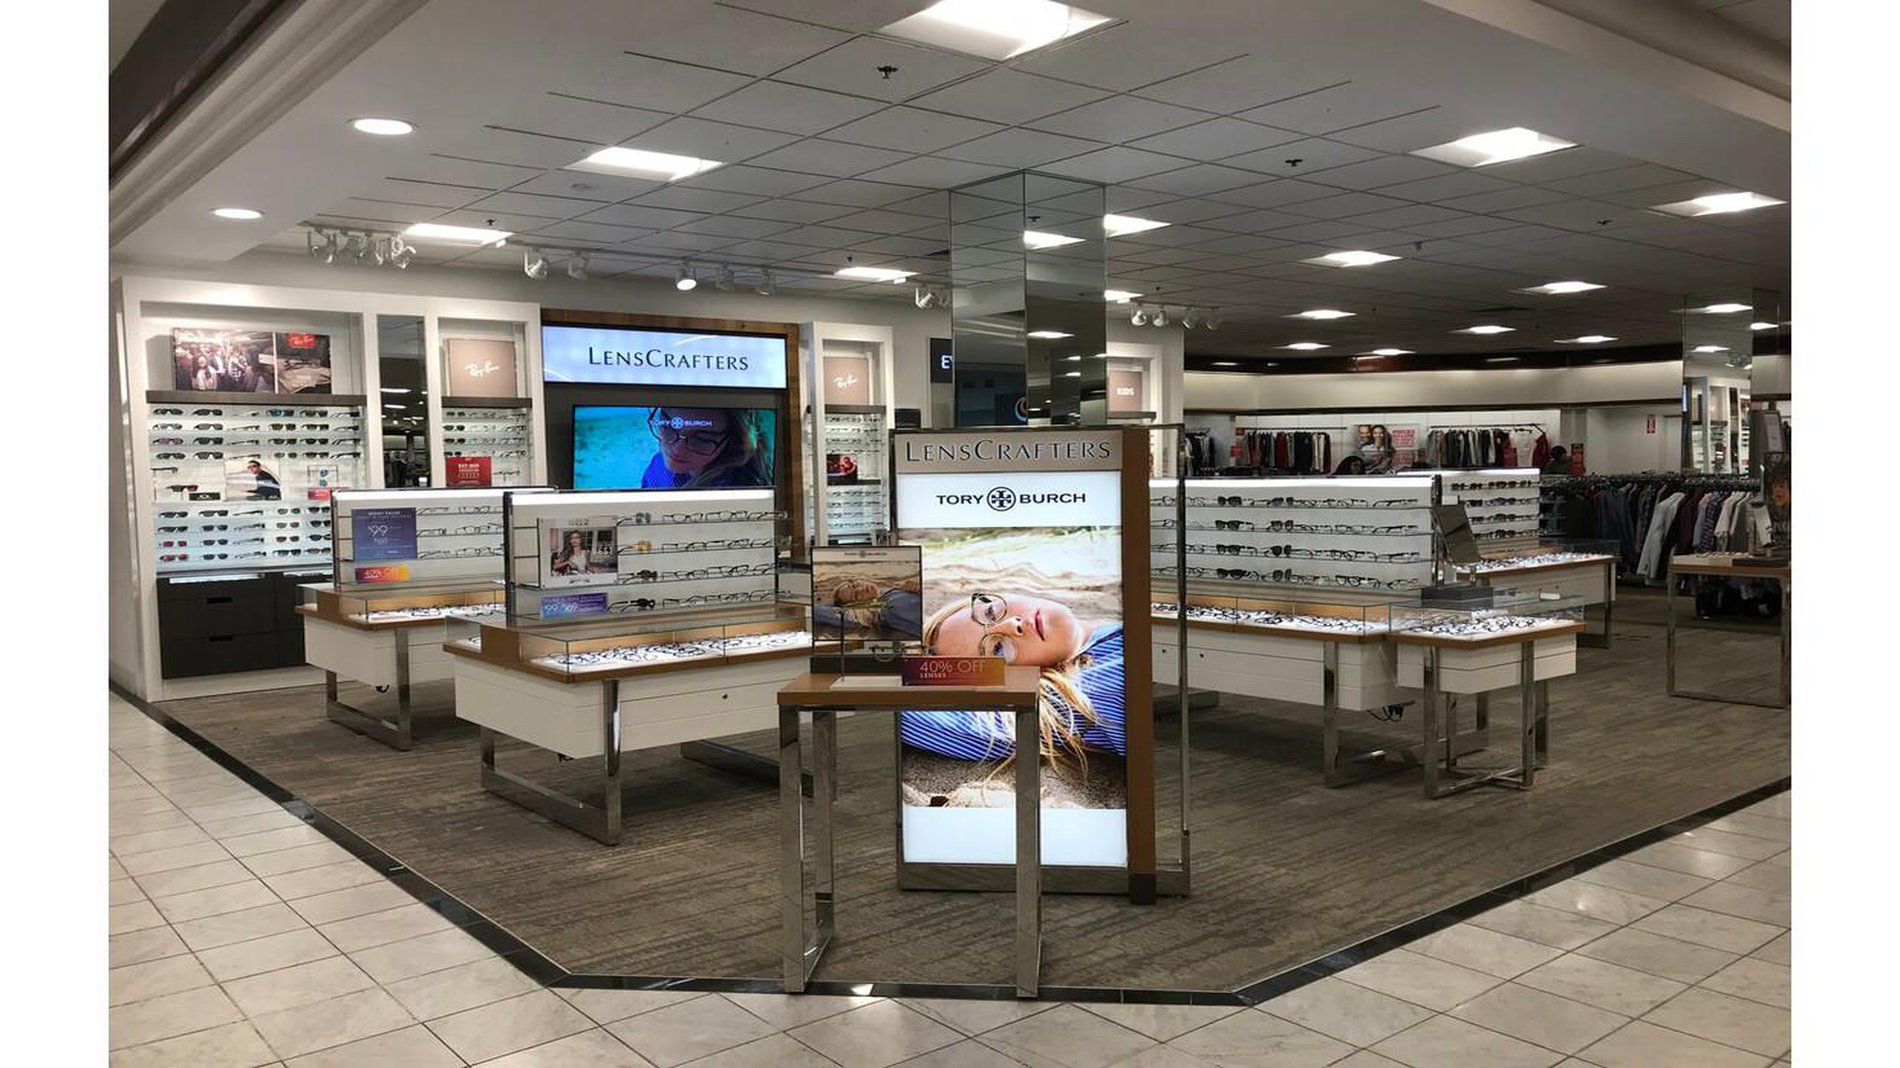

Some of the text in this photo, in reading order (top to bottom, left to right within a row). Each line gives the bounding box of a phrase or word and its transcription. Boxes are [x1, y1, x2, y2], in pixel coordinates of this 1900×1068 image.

[1117, 387, 1135, 396] KIDS
[936, 493, 1086, 505] TORY BURCH
[920, 660, 987, 673] 40% OFF
